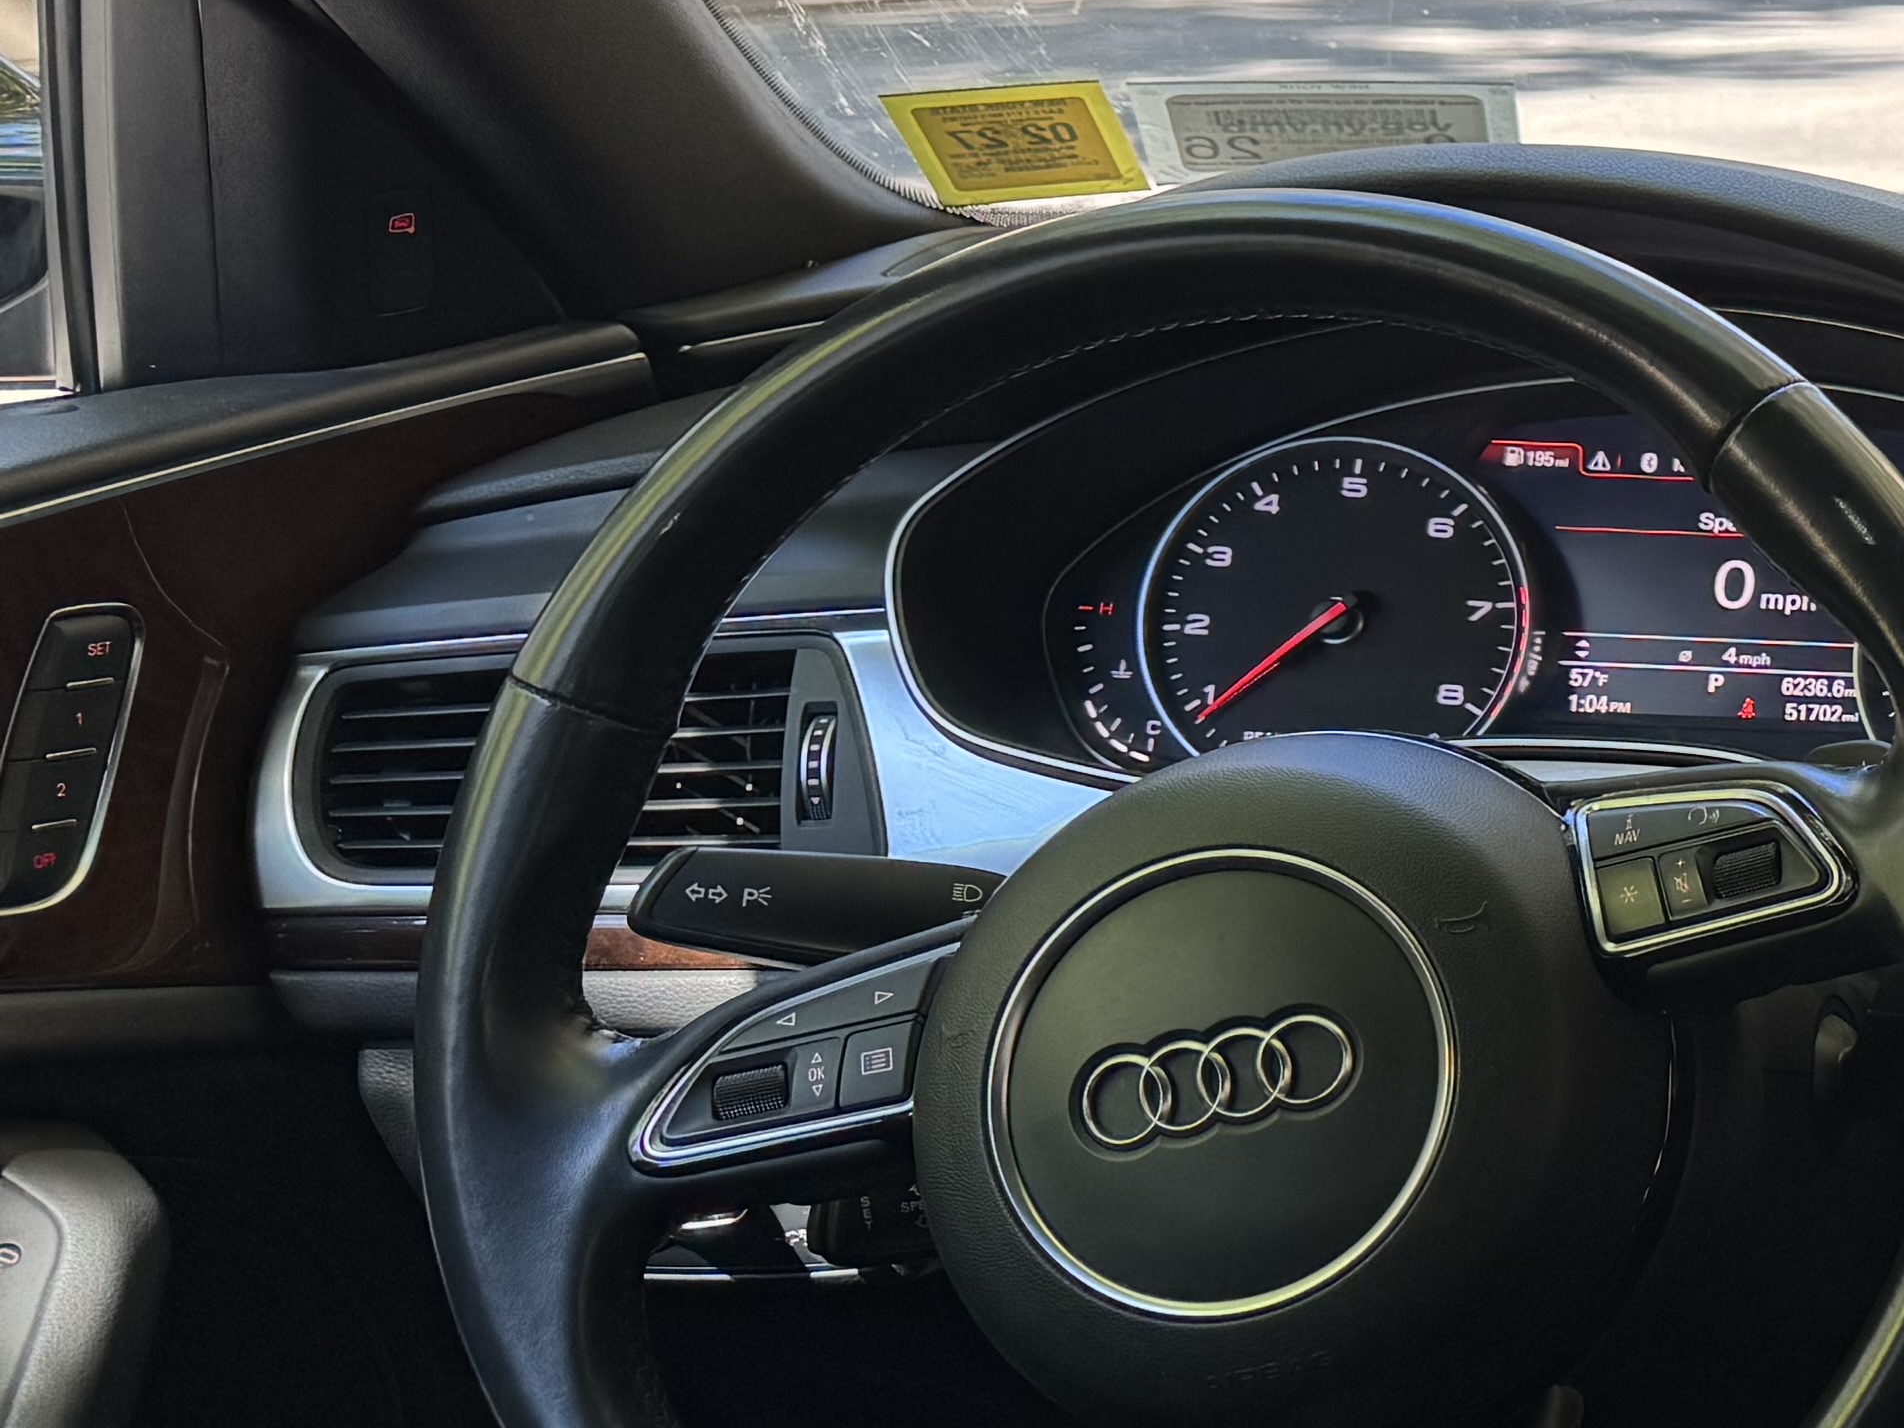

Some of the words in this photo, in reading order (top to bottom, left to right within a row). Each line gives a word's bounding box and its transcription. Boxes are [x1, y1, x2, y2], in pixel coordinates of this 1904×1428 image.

[1340, 477, 1368, 500] 5
[1254, 493, 1281, 515] 4
[1426, 517, 1455, 540] 6
[1205, 545, 1234, 568] 3
[1714, 558, 1755, 610] 0
[1099, 602, 1114, 617] H
[1465, 600, 1493, 622] 7
[1183, 613, 1211, 636] 2
[87, 641, 111, 657] SET
[1720, 647, 1738, 665] 4
[1708, 674, 1724, 694] P
[1436, 684, 1465, 707] 8
[75, 711, 83, 726] 1
[1146, 721, 1162, 736] C
[55, 782, 67, 798] 2
[1613, 828, 1641, 846] NAV
[33, 853, 57, 869] OFF
[807, 1067, 825, 1083] OK
